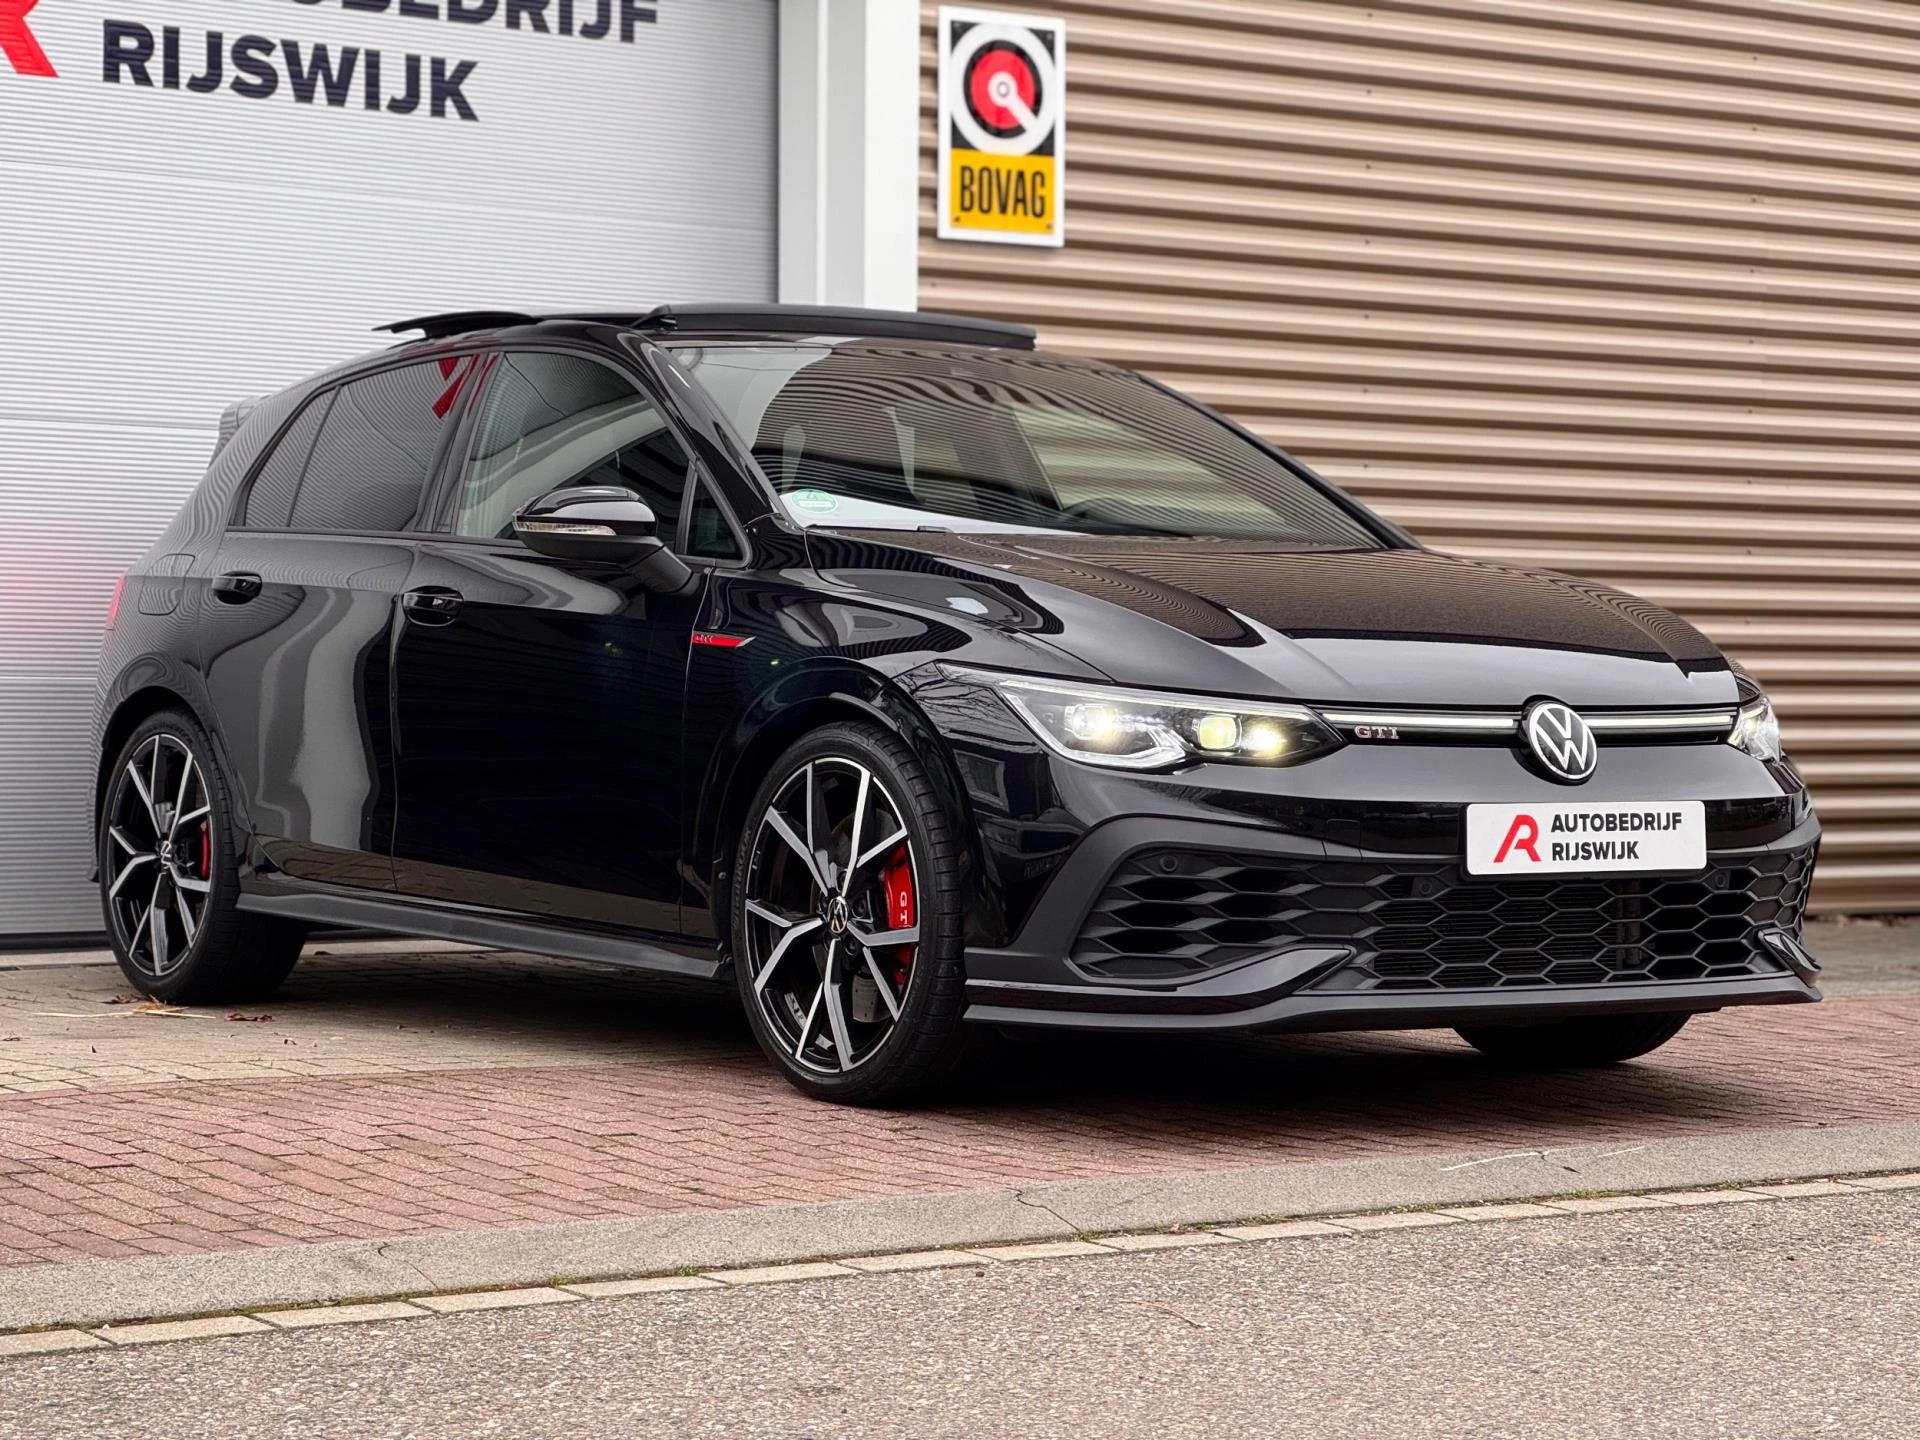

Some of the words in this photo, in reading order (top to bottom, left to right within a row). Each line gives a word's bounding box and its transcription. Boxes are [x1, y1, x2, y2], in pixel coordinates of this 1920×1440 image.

[289, 0, 658, 43] RIJF
[102, 19, 479, 121] RIJSWIJK
[960, 165, 1046, 219] BOVAG
[1354, 725, 1400, 740] GTI
[1551, 812, 1683, 833] AUTOBEDRIJF
[1552, 841, 1640, 862] RIJSWIJK
[900, 891, 912, 928] GT
